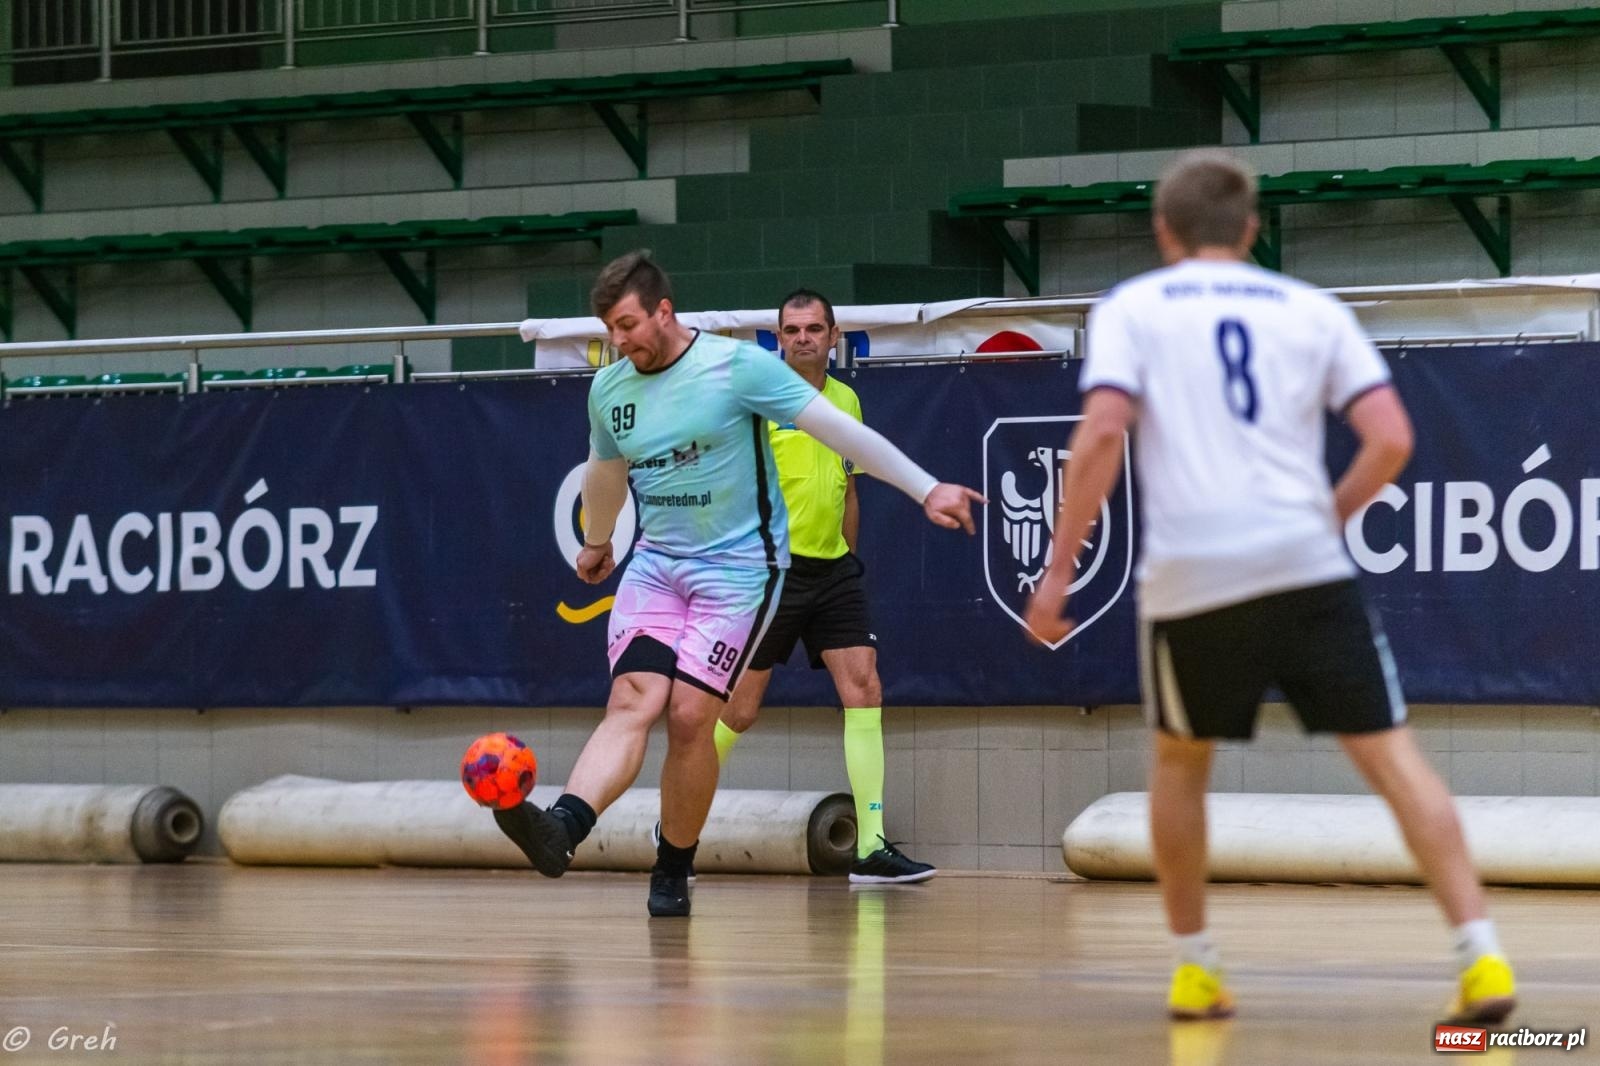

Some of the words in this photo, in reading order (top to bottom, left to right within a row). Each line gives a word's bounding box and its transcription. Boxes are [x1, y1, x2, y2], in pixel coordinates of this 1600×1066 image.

[1216, 317, 1260, 424] 8
[611, 402, 636, 434] 99
[9, 478, 379, 595] RACIBÓRZ
[707, 640, 739, 673] 99
